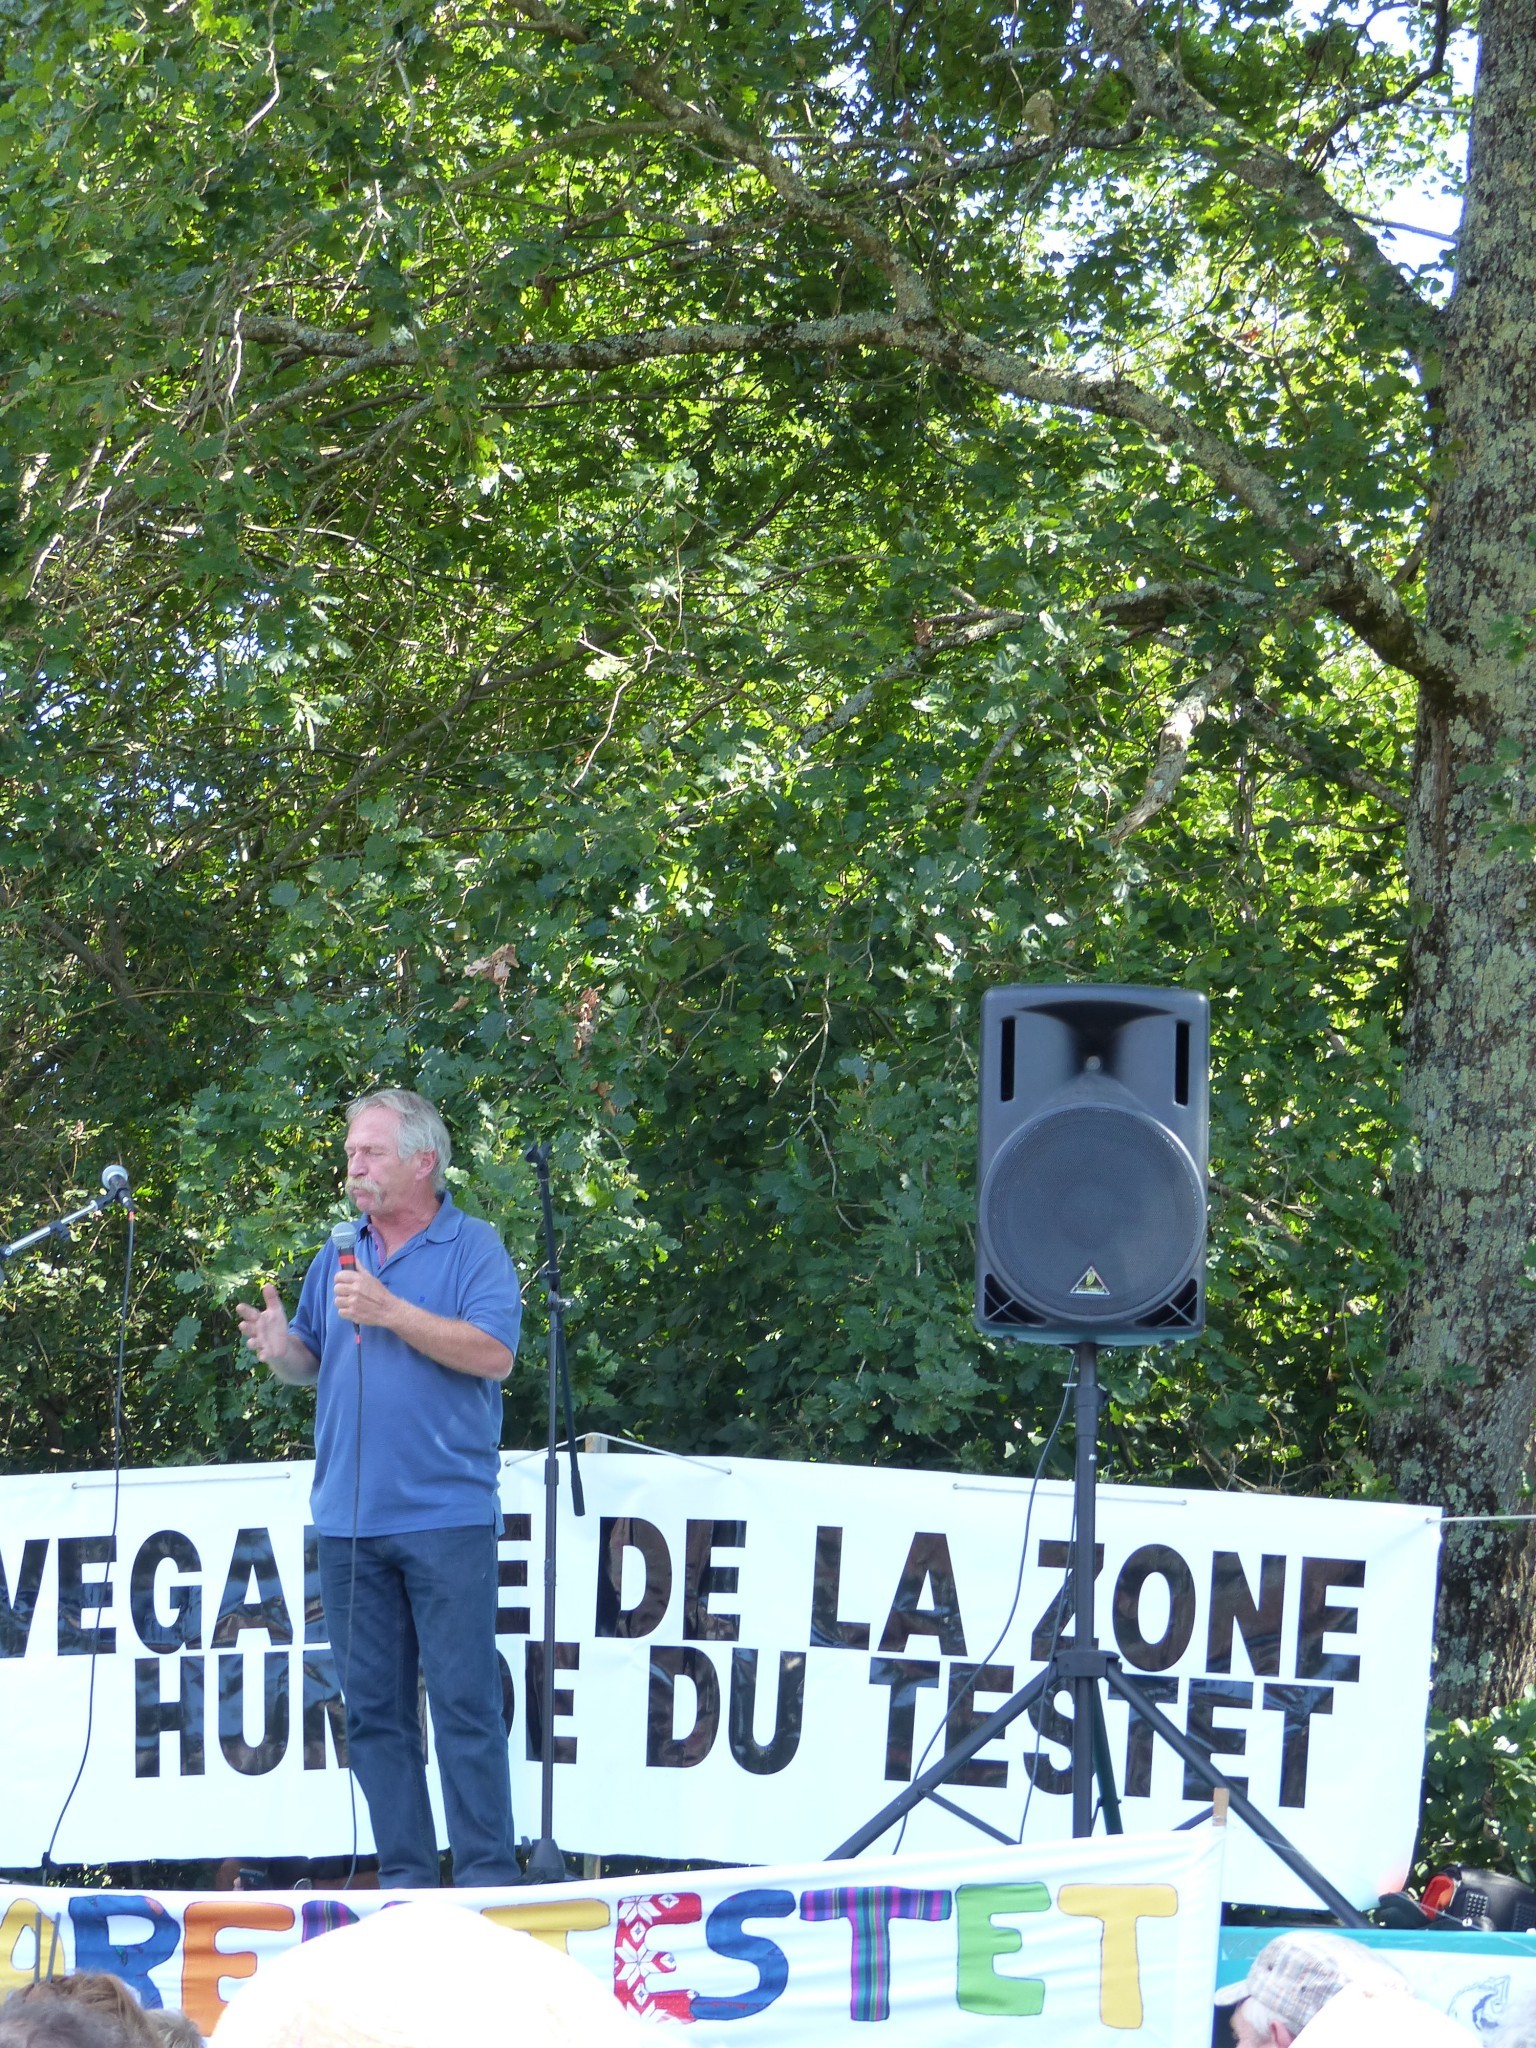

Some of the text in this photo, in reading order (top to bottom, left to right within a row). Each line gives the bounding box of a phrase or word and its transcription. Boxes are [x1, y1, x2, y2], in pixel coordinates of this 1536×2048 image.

[595, 1516, 748, 1642] DE
[809, 1525, 968, 1657] LA
[1030, 1539, 1367, 1683] ZONE
[646, 1644, 807, 1776] DU
[868, 1656, 1334, 1809] TESTET
